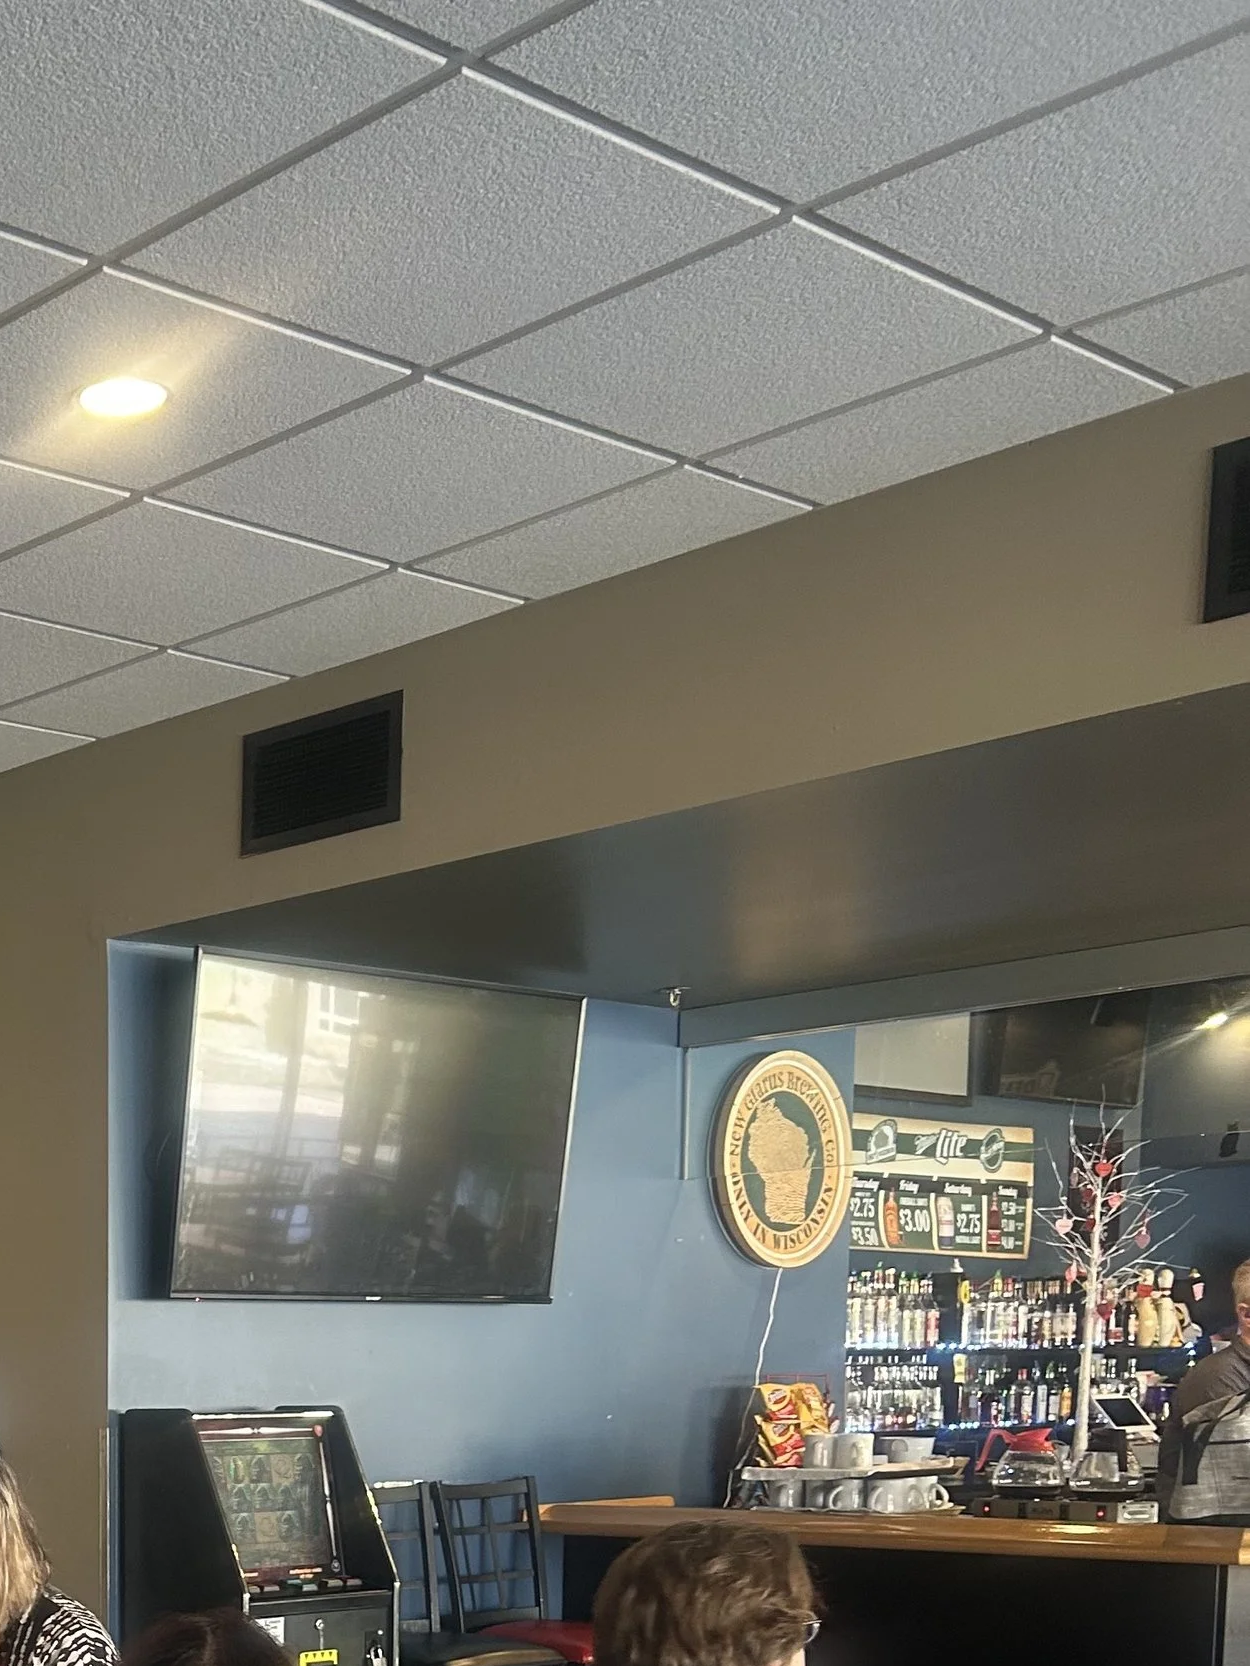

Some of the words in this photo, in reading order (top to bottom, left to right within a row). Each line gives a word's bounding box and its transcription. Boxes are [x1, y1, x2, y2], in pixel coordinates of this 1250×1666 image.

[730, 1171, 754, 1226] ONLY
[751, 1222, 769, 1246] IN
[773, 1187, 834, 1250] WISCONSIN
[899, 1208, 931, 1233] $3.00
[956, 1213, 981, 1234] $2.75
